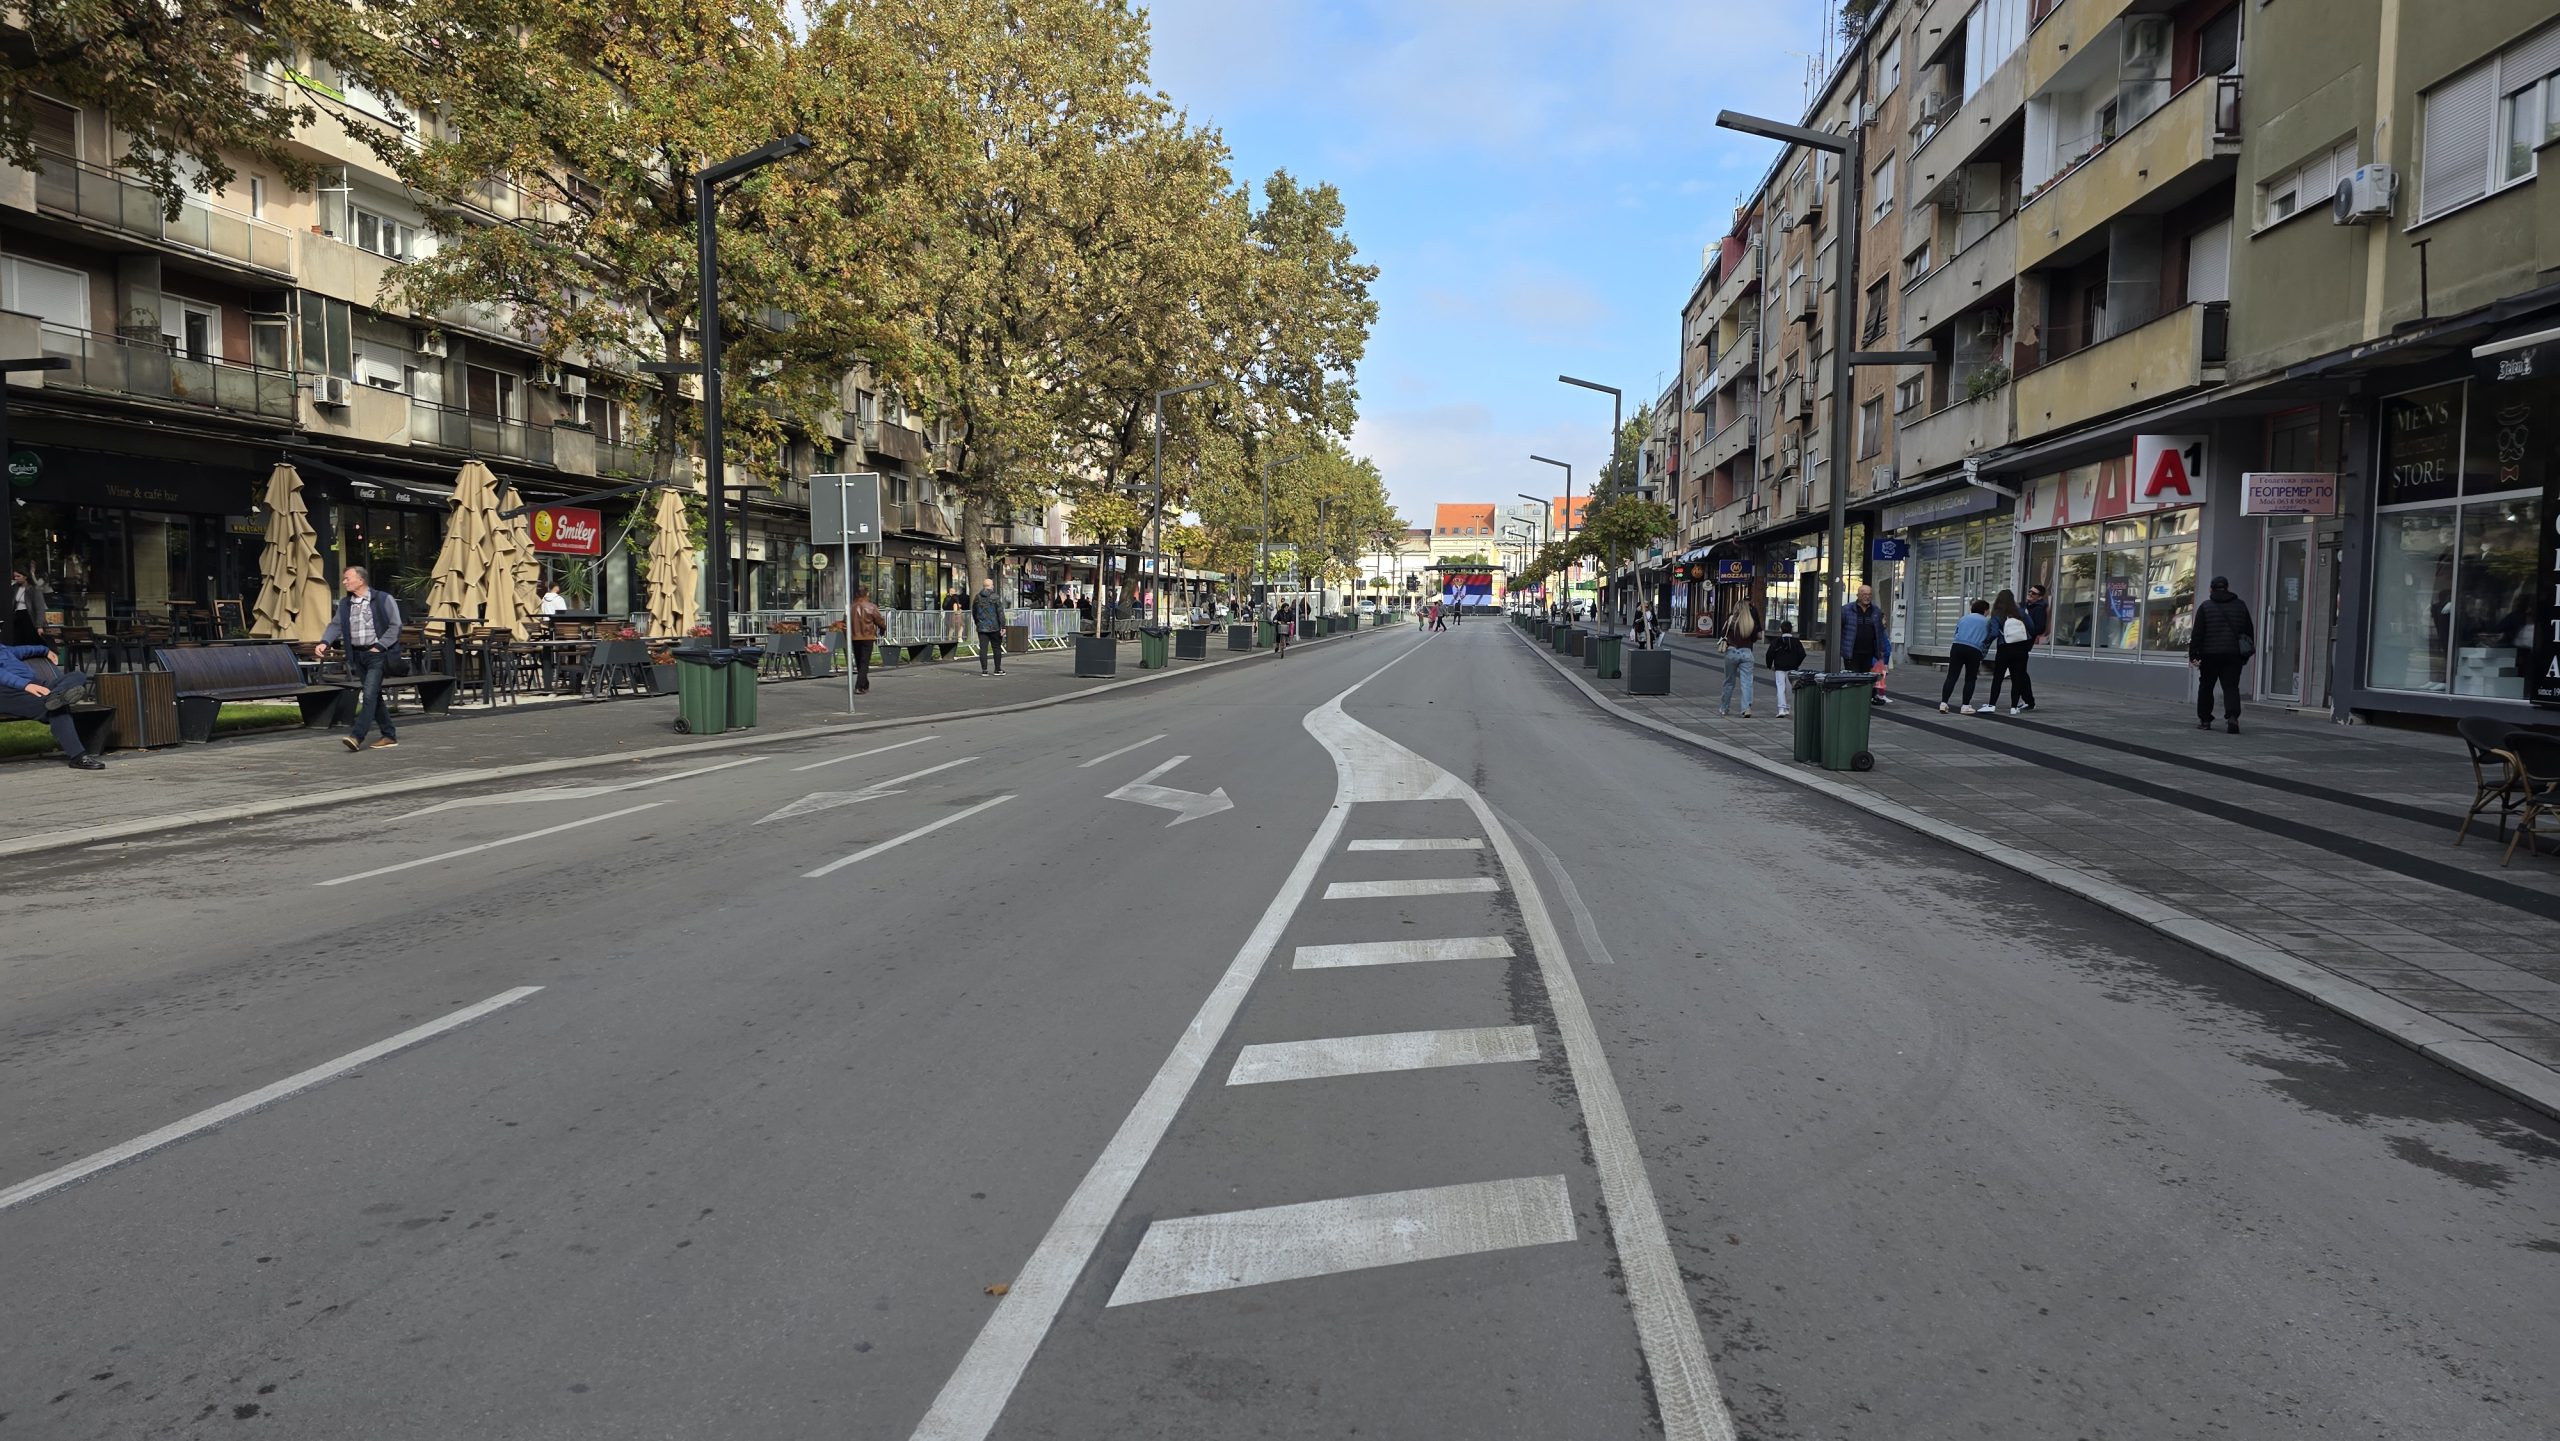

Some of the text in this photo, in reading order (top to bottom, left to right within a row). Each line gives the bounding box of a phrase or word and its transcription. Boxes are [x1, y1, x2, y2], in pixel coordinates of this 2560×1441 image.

[2497, 359, 2524, 380] Jelen
[2393, 401, 2448, 431] MEN'S
[2143, 442, 2201, 496] A1
[2393, 458, 2446, 488] STORE
[105, 484, 179, 502] Wine & café bar
[2249, 486, 2333, 497] ГЕОПРЕМЕР ПО
[556, 515, 597, 549] Smiley
